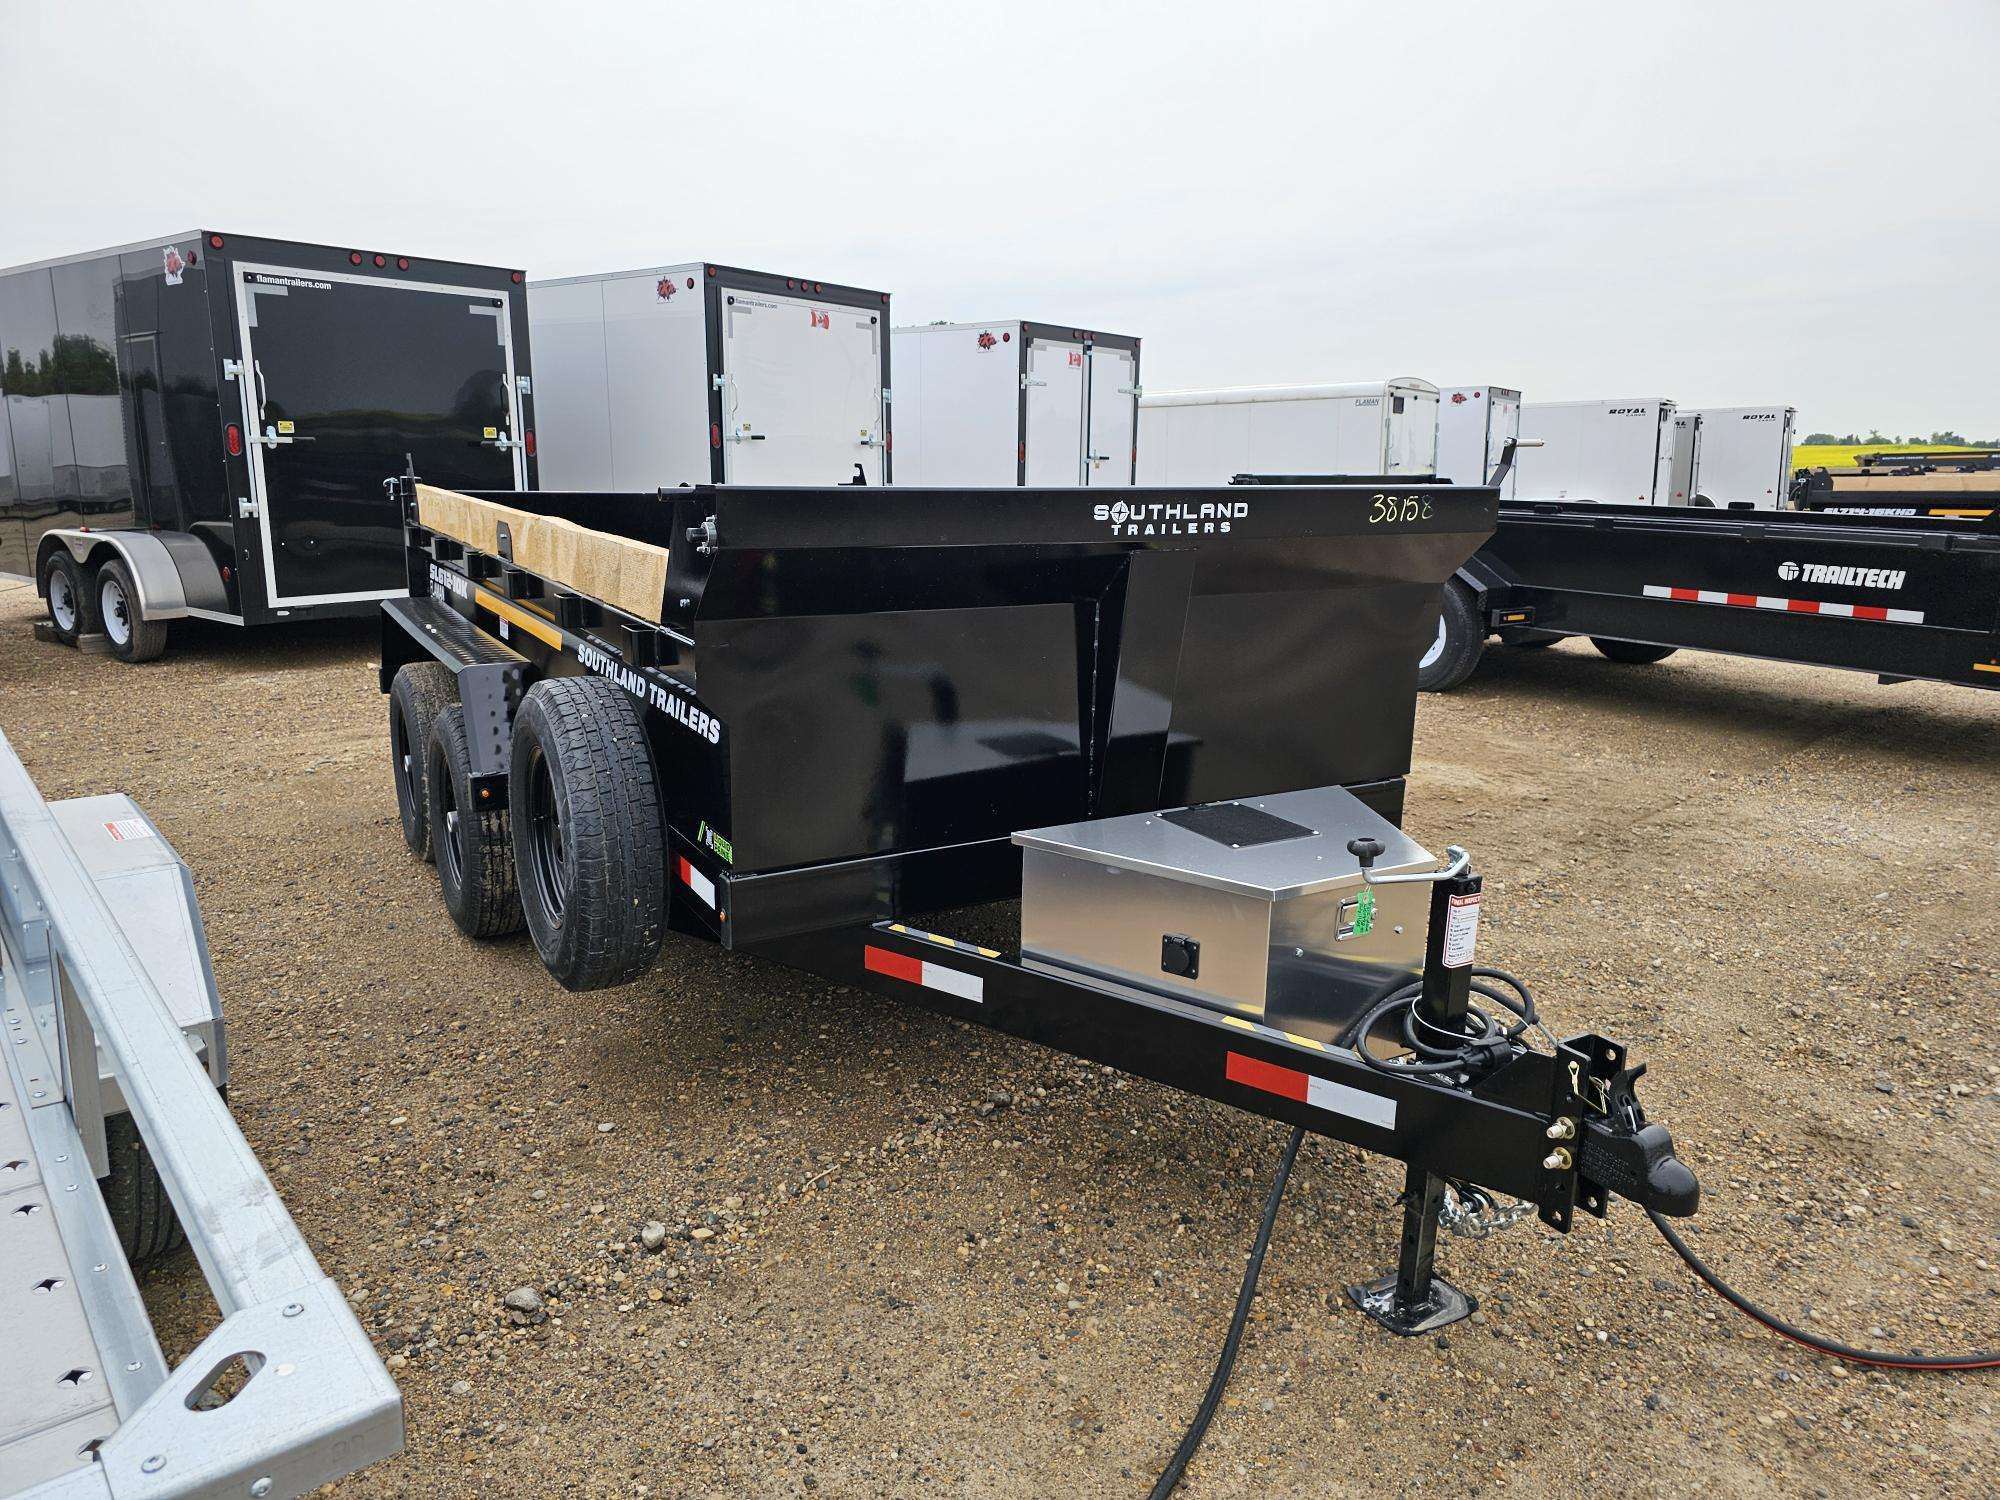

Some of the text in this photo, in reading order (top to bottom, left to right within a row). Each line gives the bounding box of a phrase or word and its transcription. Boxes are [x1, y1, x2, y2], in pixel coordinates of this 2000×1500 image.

[256, 274, 332, 290] flamantrailers.com
[1093, 500, 1249, 524] SOUTHLAND
[1369, 494, 1433, 523] 38158
[1111, 521, 1231, 536] TRAILERS
[1801, 563, 1907, 590] TRAILTECH
[577, 643, 721, 745] SOUTHLAND TRAILERS
